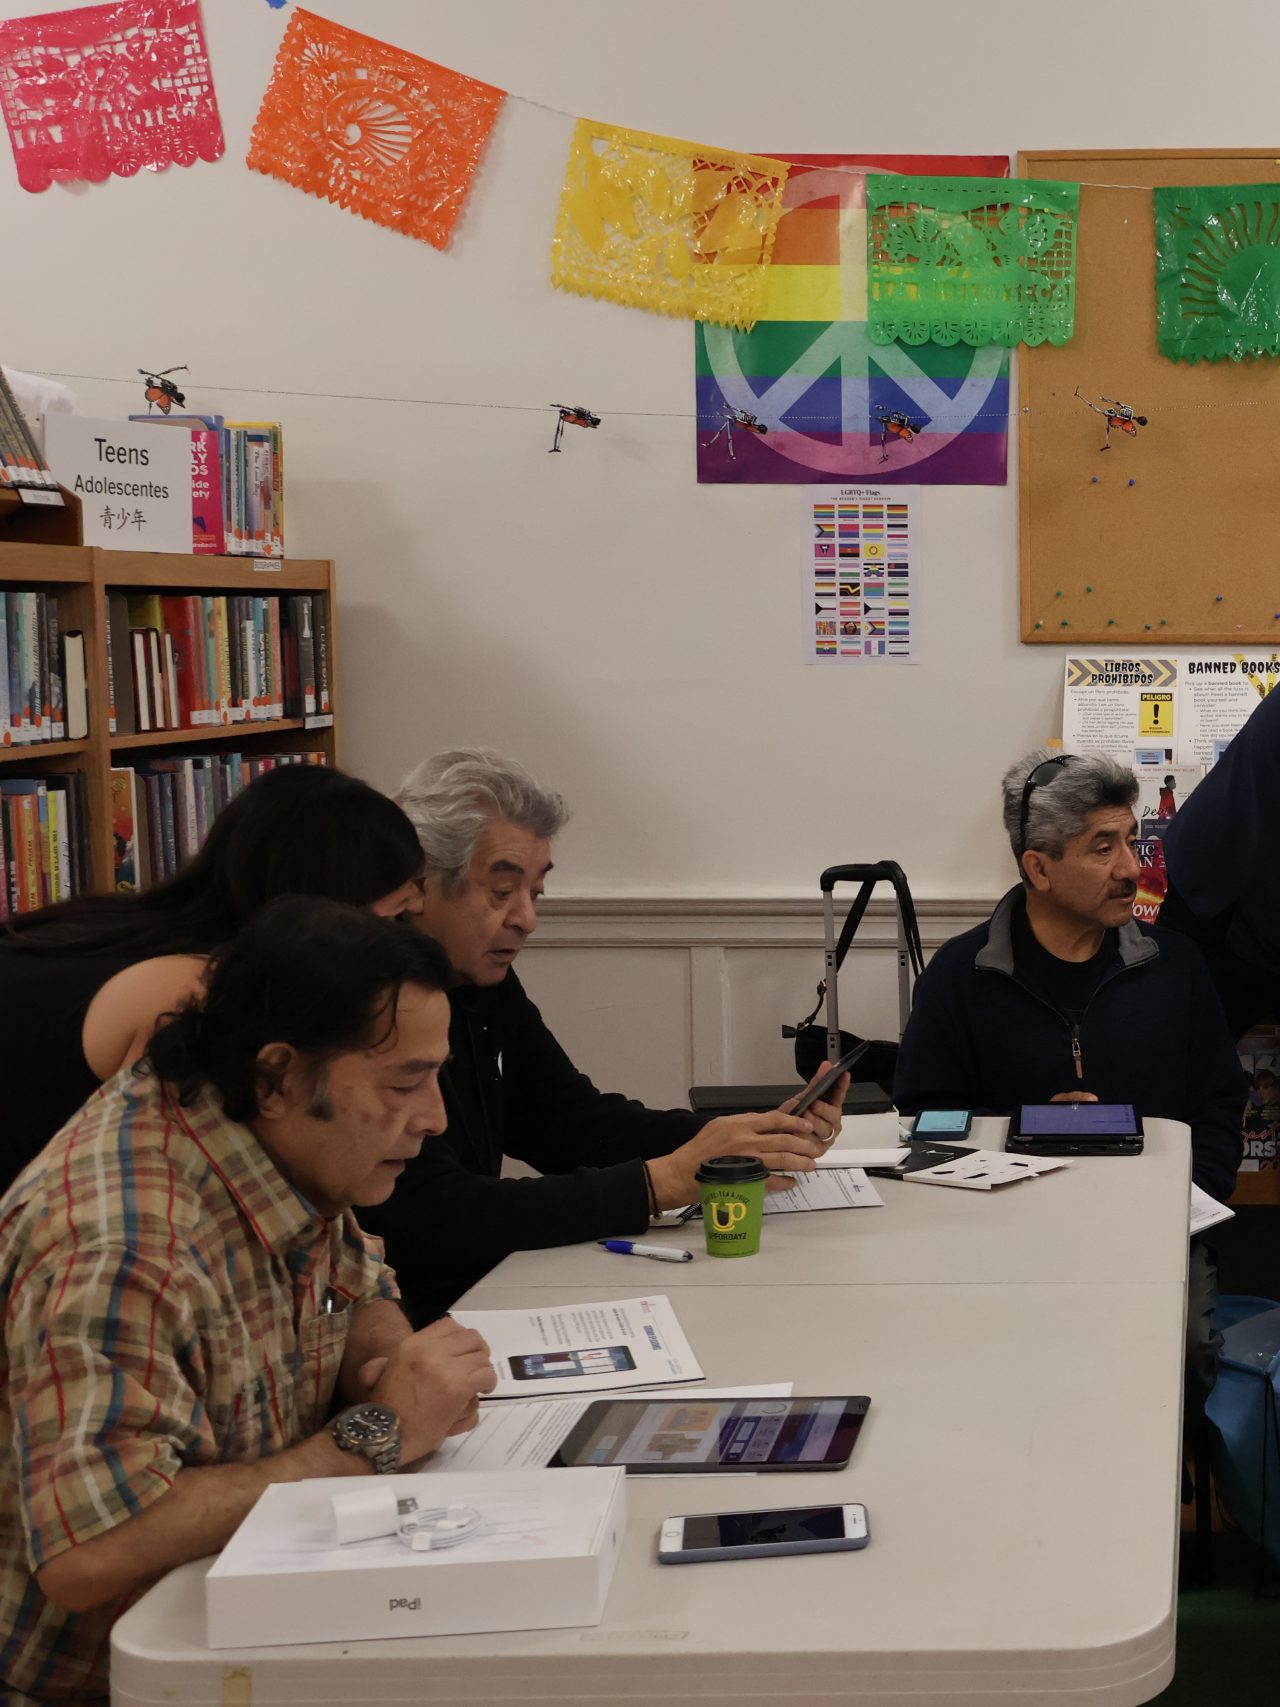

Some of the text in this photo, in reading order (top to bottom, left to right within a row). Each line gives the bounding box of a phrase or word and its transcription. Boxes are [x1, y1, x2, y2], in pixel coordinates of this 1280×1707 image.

[94, 437, 150, 466] Teens
[74, 474, 169, 499] Adolescentes
[99, 505, 147, 532] 青少年
[1104, 662, 1141, 673] LIBROS
[1188, 661, 1280, 674] BANNED BOOKS
[1091, 673, 1153, 685] PROHIBIDOS
[1141, 693, 1171, 701] PELIGRO
[389, 1597, 422, 1612] iPad
